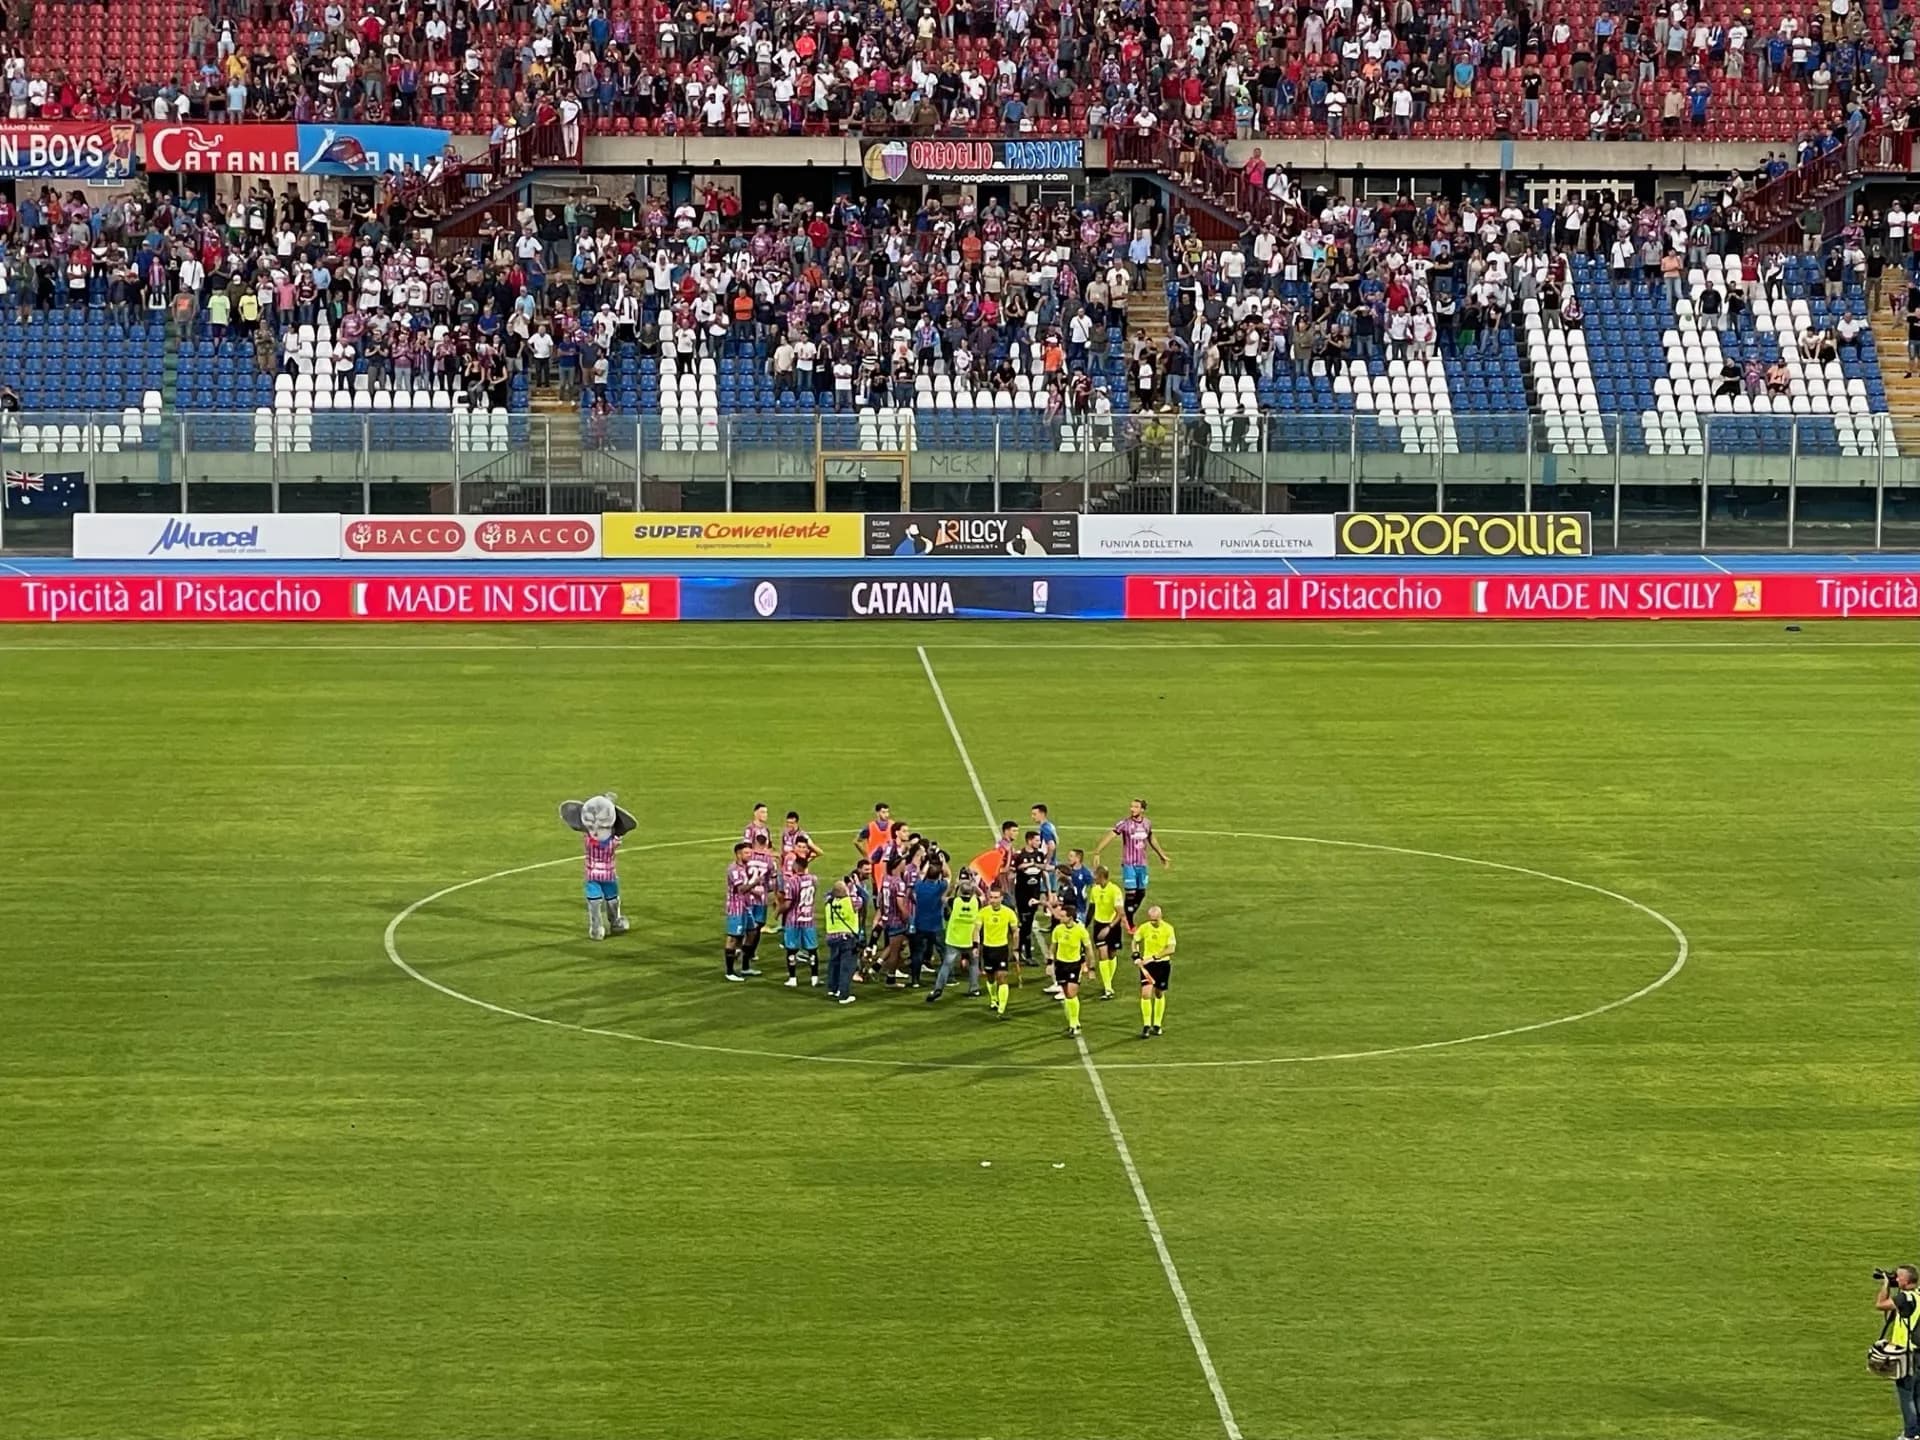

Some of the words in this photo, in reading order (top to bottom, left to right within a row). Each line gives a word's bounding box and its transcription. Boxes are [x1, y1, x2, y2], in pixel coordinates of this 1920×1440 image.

[30, 134, 103, 167] BOYS
[153, 127, 299, 171] CATANIA
[911, 140, 993, 170] ORGOGLIO
[1005, 140, 1083, 170] PASSIONE
[148, 518, 259, 555] Muracel
[376, 528, 460, 545] BACCO
[505, 528, 589, 545] BACCO
[936, 519, 1008, 543] TRILOGY
[1100, 539, 1140, 548] FUNIVIA
[1142, 539, 1193, 548] DELL'ETNA
[1220, 539, 1260, 548] FUNIVIA
[1262, 539, 1313, 548] DELL'ETNA
[21, 581, 129, 621] Tipicità
[140, 580, 162, 612] al
[175, 579, 321, 612] Pistacchio
[387, 585, 473, 612] MADE
[484, 585, 513, 612] IN
[522, 584, 608, 612] SICILY
[851, 582, 954, 614] CATANIA
[1153, 580, 1256, 619] Tipicità
[1266, 579, 1289, 610] al
[1302, 578, 1442, 610] Pistacchio
[1505, 583, 1589, 610] MADE
[1600, 583, 1629, 610] IN
[1637, 582, 1721, 610] SICILY
[1816, 577, 1919, 617] Tipicità
